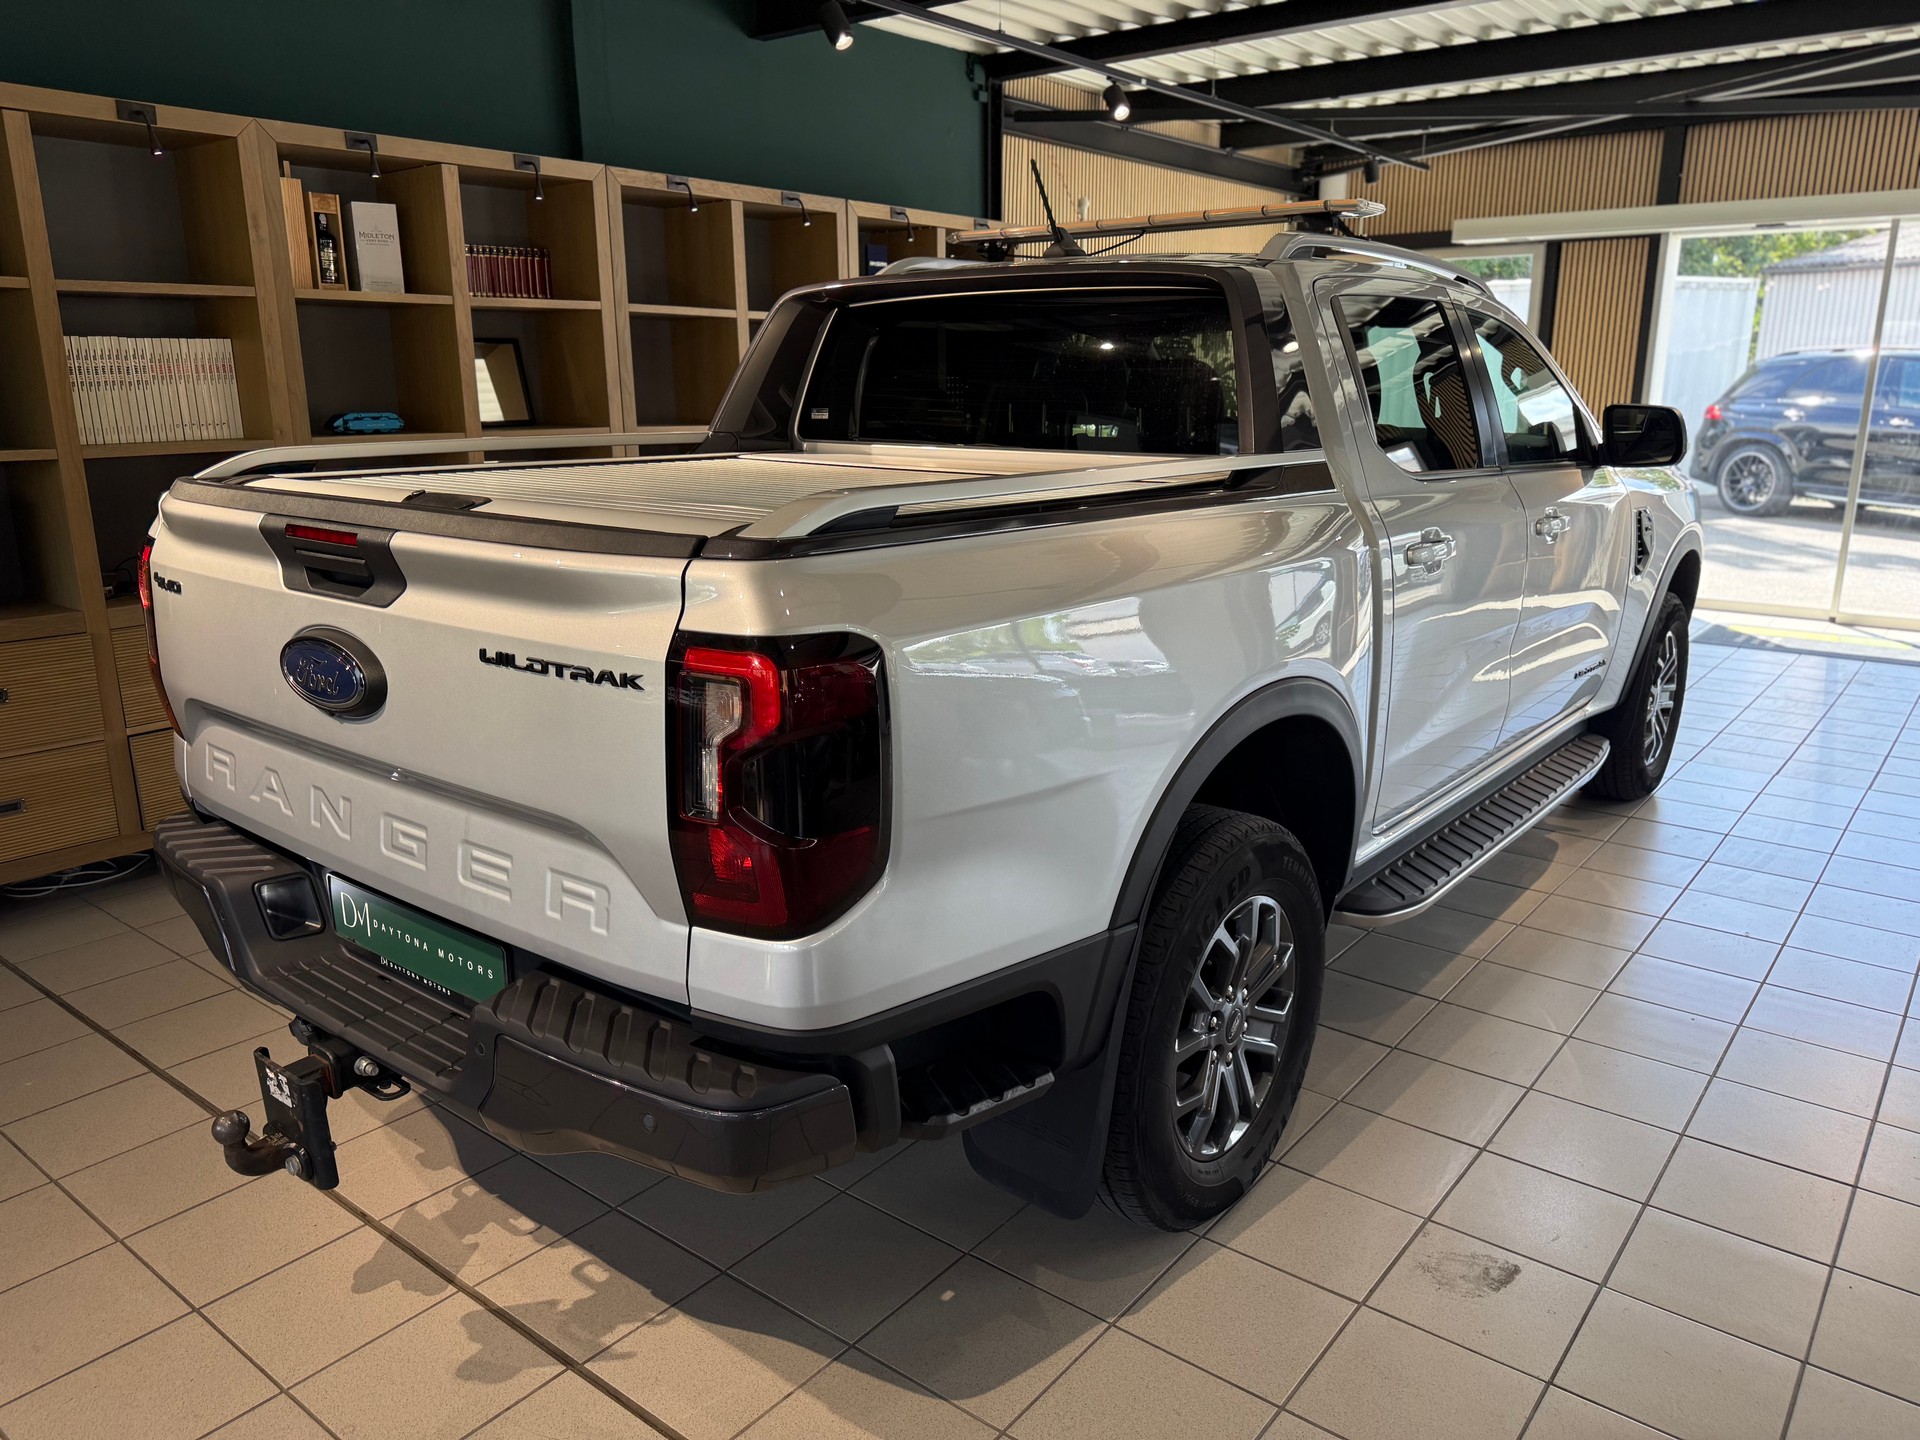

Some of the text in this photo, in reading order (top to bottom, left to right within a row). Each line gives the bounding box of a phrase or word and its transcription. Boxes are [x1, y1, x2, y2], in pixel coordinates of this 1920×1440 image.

[359, 232, 395, 240] MIDLETON
[296, 656, 339, 695] Ford
[479, 648, 645, 691] WILDTRAK
[205, 742, 611, 936] RANGER
[373, 919, 428, 951] DAYTONA
[438, 948, 493, 979] MOTORS
